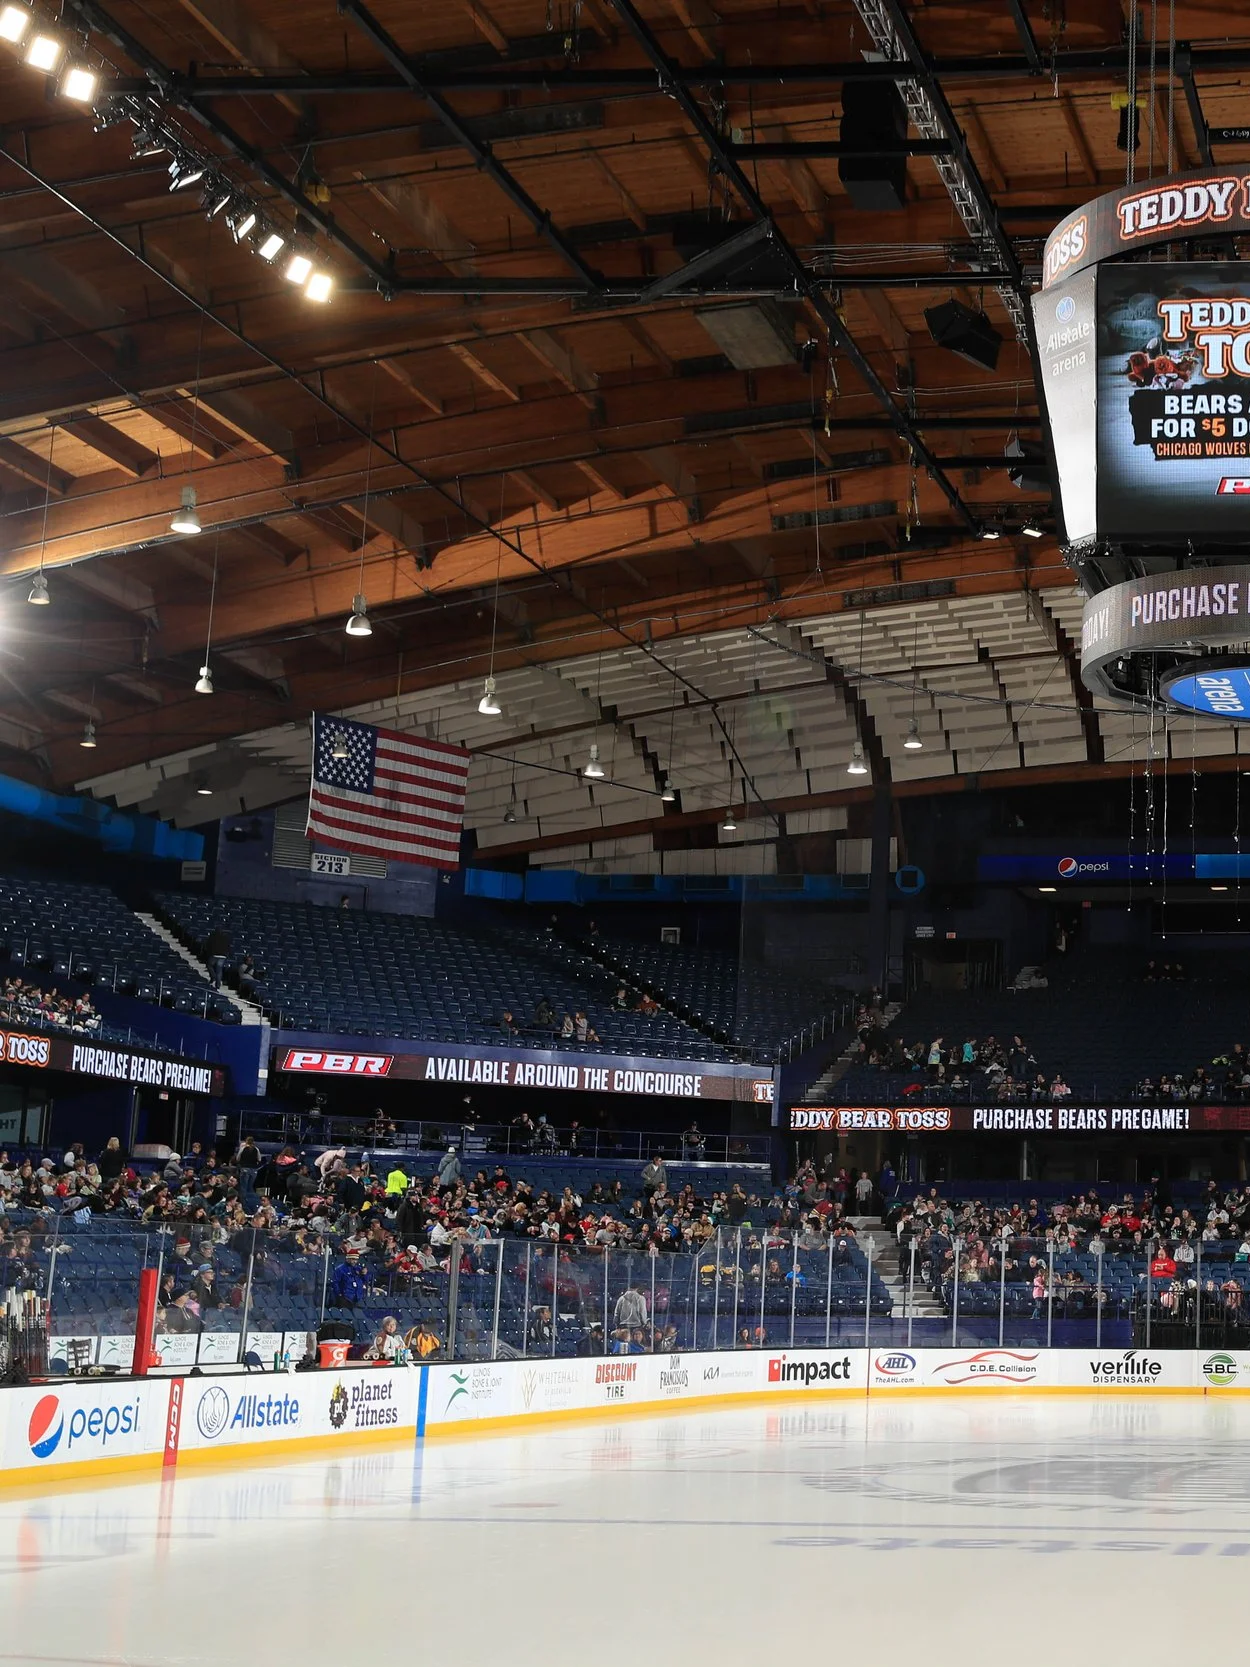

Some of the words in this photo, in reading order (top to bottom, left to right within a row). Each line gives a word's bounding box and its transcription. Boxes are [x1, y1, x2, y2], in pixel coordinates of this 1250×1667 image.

[1120, 179, 1236, 236] TEDDY
[1046, 320, 1090, 354] Allstate
[1052, 351, 1087, 377] arena
[1164, 394, 1243, 415] BEARS
[1151, 418, 1196, 438] FOR
[1201, 418, 1226, 438] $5
[1156, 442, 1202, 457] CHICAGO
[1205, 442, 1246, 456] WOLVES
[1131, 582, 1240, 628] PURCHASE
[1196, 677, 1245, 713] arena
[314, 853, 348, 864] SECTION
[317, 861, 343, 874] 213
[1079, 861, 1109, 873] pepsi
[8, 1035, 49, 1064] TOSS
[71, 1044, 129, 1080] PURCHASE
[129, 1055, 162, 1085] BEARS
[164, 1062, 212, 1093] PREGAME!
[290, 1050, 387, 1074] PBR
[425, 1057, 510, 1084] AVAILABLE
[514, 1063, 579, 1088] AROUND
[583, 1067, 609, 1091] THE
[613, 1070, 702, 1096] CONCOURSE
[838, 1109, 892, 1128] BEAR
[898, 1109, 948, 1129] TOSS
[973, 1108, 1053, 1129] PURCHASE
[1058, 1108, 1107, 1129] BEARS
[1111, 1108, 1190, 1129] PREGAME!
[595, 1362, 638, 1384] DISCOUNT
[781, 1354, 851, 1386] impact
[882, 1357, 909, 1369] AHL
[969, 1364, 998, 1373] C.D.E.
[998, 1364, 1037, 1373] Collision
[1089, 1353, 1162, 1376] verilife
[875, 1376, 915, 1384] TheAHL.com
[1093, 1375, 1158, 1384] DISPENSARY
[351, 1379, 393, 1409] planet
[606, 1385, 625, 1398] TIRE
[68, 1396, 141, 1449] pepsi
[168, 1383, 181, 1449] CCM
[229, 1392, 300, 1430] Allstate
[354, 1403, 398, 1427] fitness
